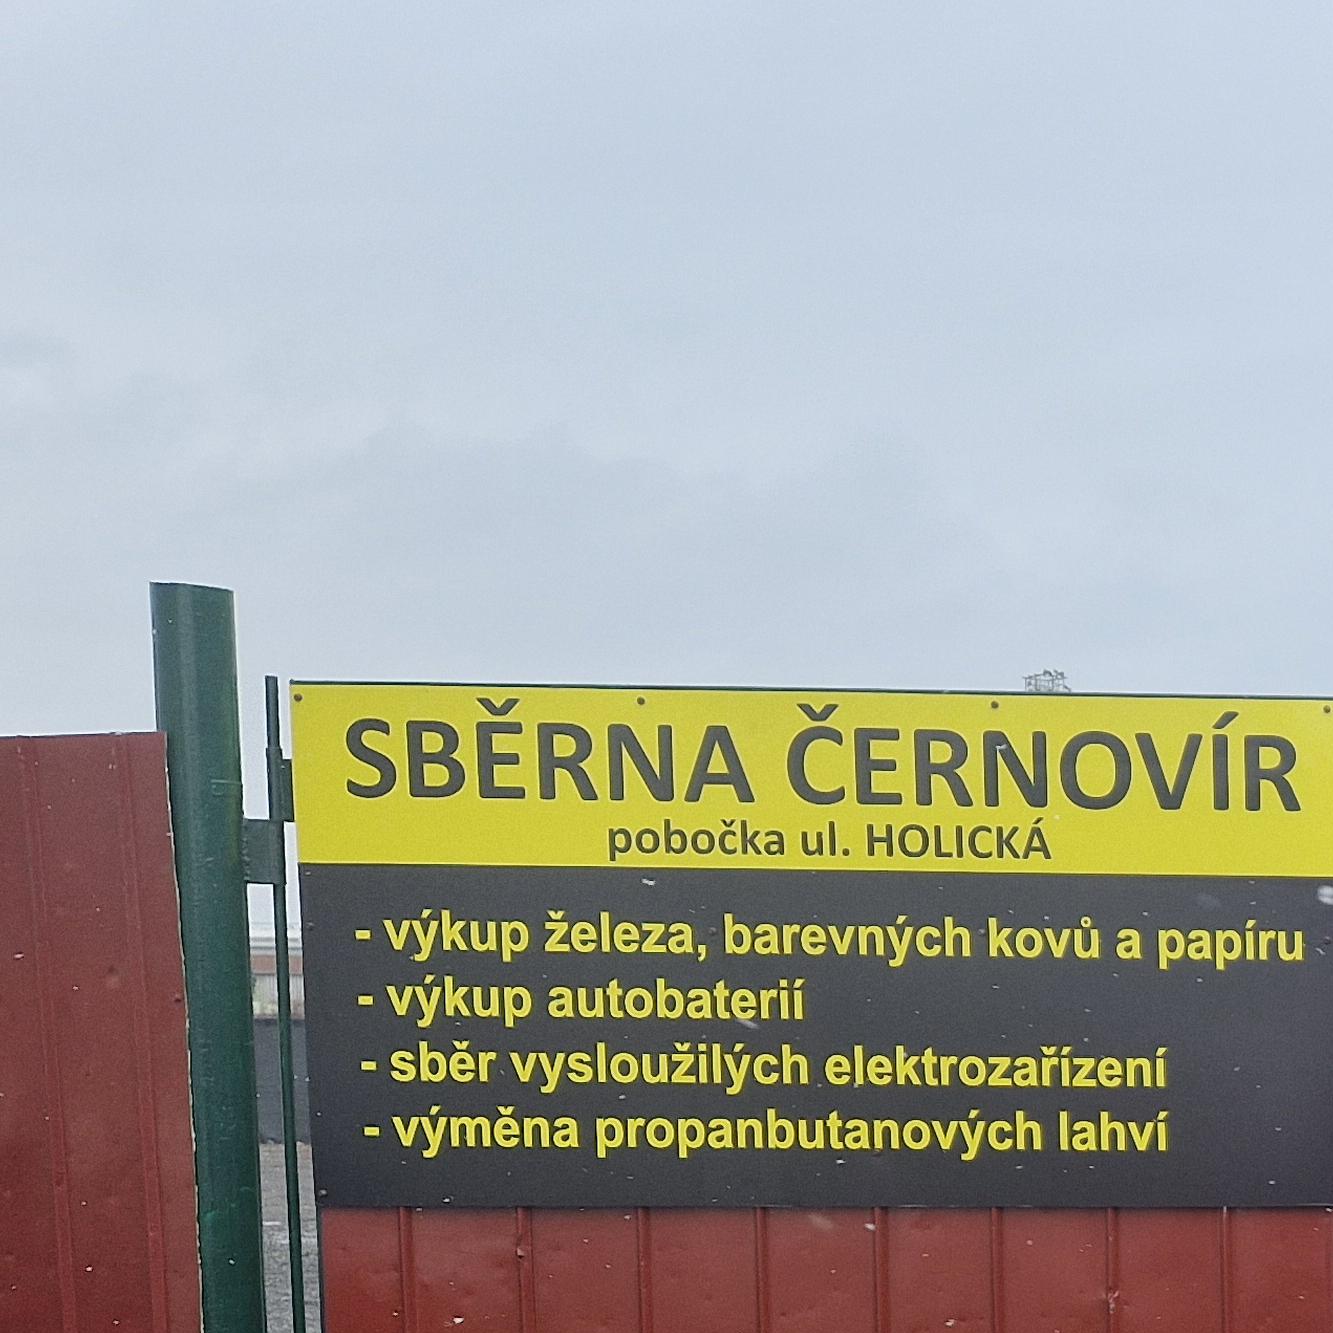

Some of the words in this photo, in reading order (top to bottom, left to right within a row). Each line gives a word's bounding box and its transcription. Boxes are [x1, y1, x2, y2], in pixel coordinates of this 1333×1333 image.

[345, 697, 756, 803] SBĚRNA
[786, 702, 1302, 811] ČERNOVÍR
[608, 819, 785, 861] pobočka
[801, 821, 851, 857] ul.
[866, 817, 1052, 860] HOLICKÁ
[383, 909, 530, 961] výkup
[544, 912, 707, 961] železa,
[723, 914, 971, 967] barevných
[988, 917, 1101, 959] kovů
[1115, 928, 1143, 960] a
[1157, 920, 1305, 971] papíru
[386, 974, 532, 1027] výkup
[547, 978, 806, 1021] autobaterií
[390, 1040, 496, 1083] sběr
[510, 1043, 810, 1095] vysloužilých
[824, 1046, 1167, 1088] elektrozařízení
[392, 1106, 580, 1158] výměna
[595, 1109, 1043, 1161] propanbutanových
[1059, 1111, 1169, 1152] lahví
